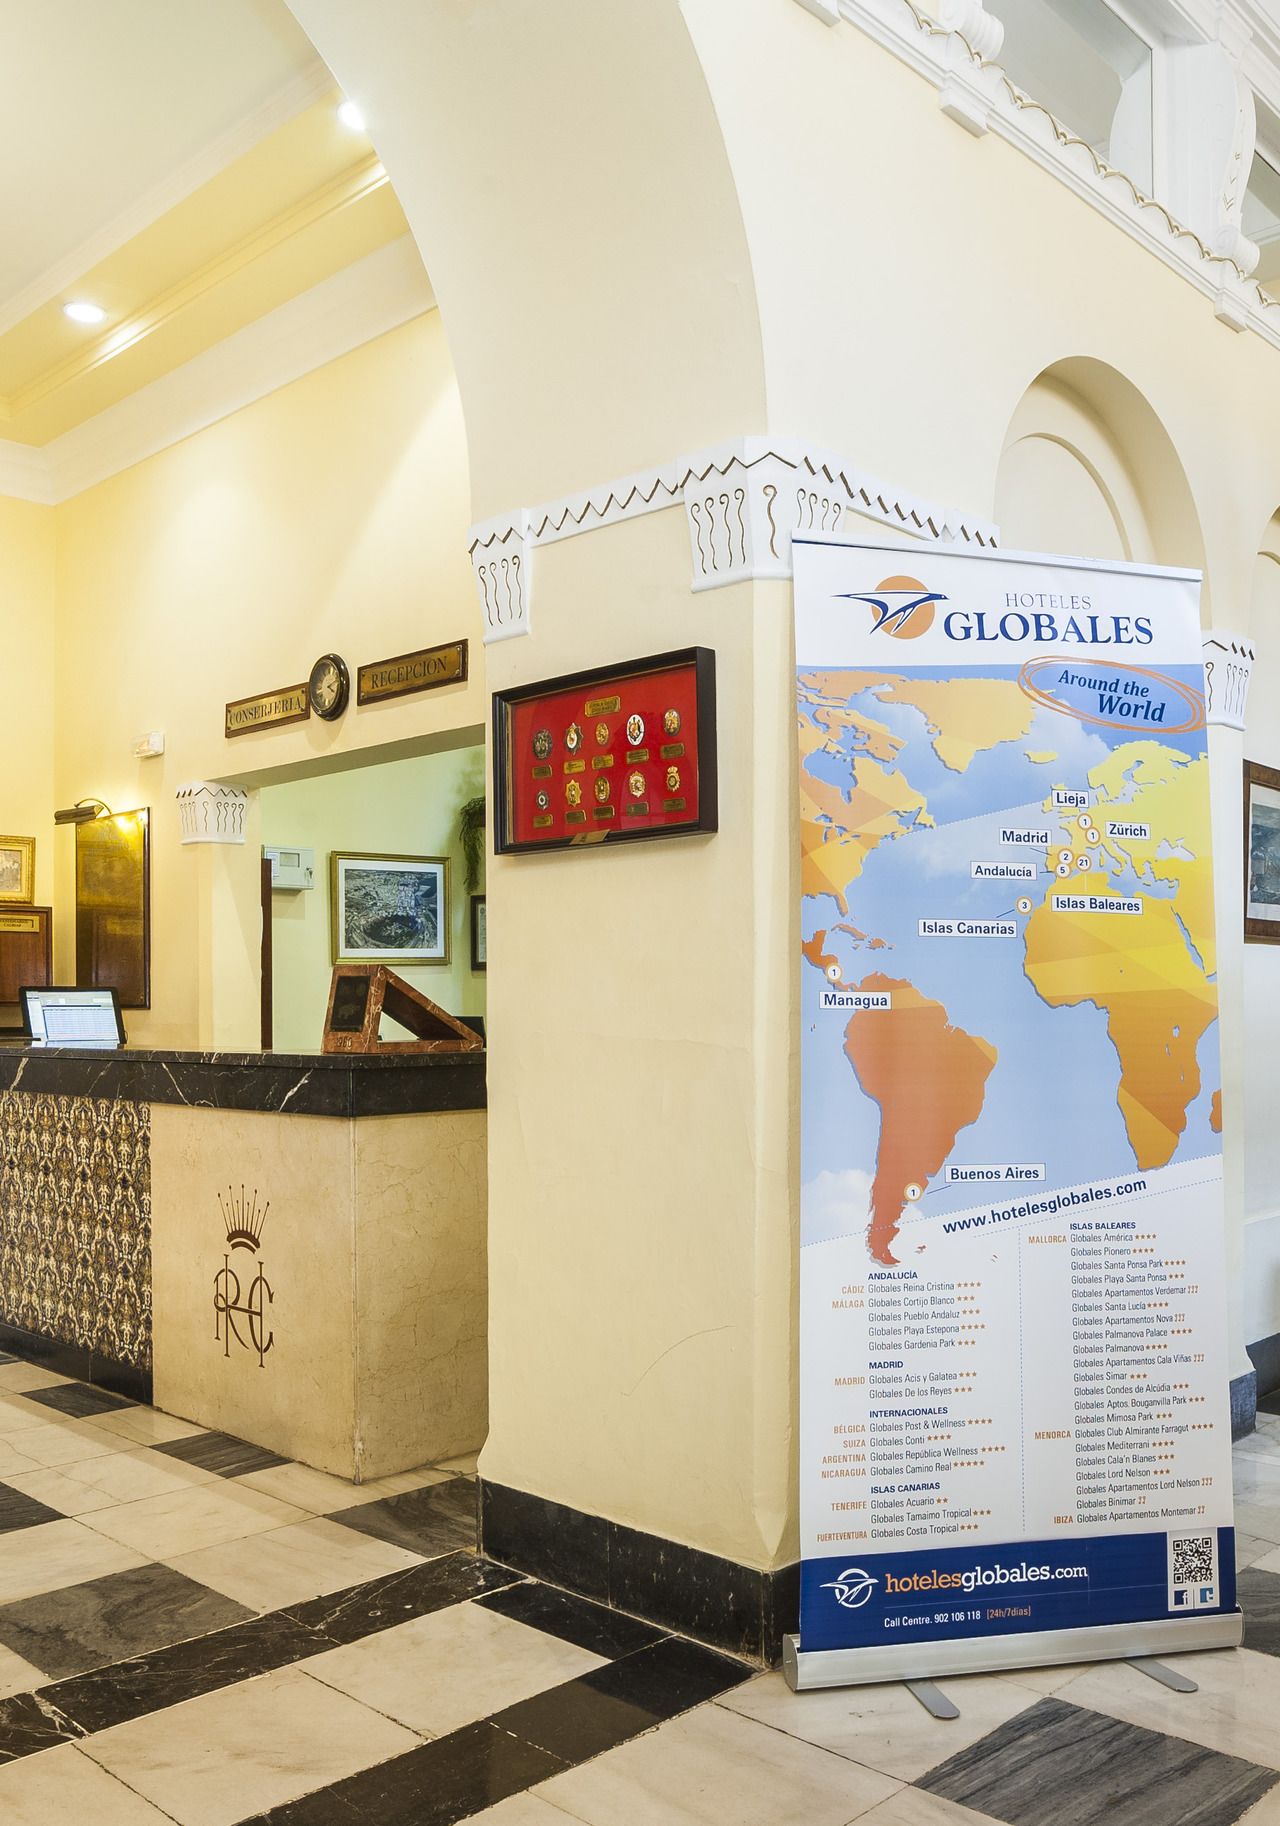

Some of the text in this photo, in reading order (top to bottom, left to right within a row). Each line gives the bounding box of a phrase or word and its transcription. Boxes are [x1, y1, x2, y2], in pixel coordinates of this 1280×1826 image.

[1005, 593, 1092, 610] HOTELES
[943, 611, 1154, 646] GLOBALES
[371, 656, 447, 690] RECEPCION
[1058, 670, 1149, 697] Around the
[229, 696, 301, 725] CONSERJERIA
[1099, 694, 1166, 722] World
[1056, 792, 1086, 807] Lieja
[1109, 823, 1147, 837] Zürich
[1002, 831, 1048, 844] Madrid
[975, 866, 1032, 877] Andalucía
[1056, 898, 1140, 912] Islas Baleares
[922, 922, 1014, 935] Islas Canarias
[824, 994, 887, 1009] Managua
[950, 1167, 1040, 1180] Buenos Aires
[942, 1179, 1147, 1234] www.hotelesglobales.com
[1029, 1235, 1067, 1244] MALLORCA
[1070, 1233, 1102, 1243] Globales
[1071, 1247, 1131, 1256] Globales Pionero
[1071, 1259, 1163, 1270] Globales Santa Ponsa Park
[868, 1271, 918, 1280] ANDALUCÍA
[1071, 1273, 1167, 1285] Globales Playa Santa Ponsa
[868, 1284, 901, 1293] Globales
[903, 1283, 924, 1291] Reina
[926, 1282, 955, 1290] Cristina
[868, 1298, 902, 1307] Globales
[904, 1297, 929, 1307] Cortijo
[930, 1296, 955, 1305] Blanco
[1072, 1303, 1103, 1312] Globales
[1105, 1302, 1126, 1311] Santa
[868, 1310, 960, 1322] Globales Pueblo Andaluz
[869, 1324, 960, 1336] Globales Playa Estepona
[1073, 1328, 1168, 1340] Globales Palmanova Palace
[869, 1339, 955, 1351] Globales Gardenia Park
[1073, 1344, 1144, 1354] Globales Palmanova
[869, 1361, 904, 1369] MADRID
[1073, 1358, 1104, 1368] Globales
[1106, 1357, 1155, 1368] Apartamentos
[1157, 1356, 1171, 1364] Cala
[834, 1372, 957, 1386] MADRID Globales Acis y Galatea
[869, 1386, 952, 1399] Globales De los Reyes
[1074, 1387, 1104, 1396] Globales
[1106, 1385, 1133, 1394] Condes
[1135, 1385, 1144, 1393] de
[870, 1407, 948, 1418] INTERNACIONALES
[1075, 1412, 1153, 1424] Globales Mimosa Park
[870, 1422, 903, 1432] Globales
[905, 1421, 921, 1430] Post
[923, 1420, 929, 1429] &
[932, 1419, 966, 1428] Wellness
[1035, 1431, 1071, 1440] MENORCA
[1075, 1429, 1105, 1438] Globales
[1107, 1427, 1123, 1436] Club
[1125, 1425, 1160, 1435] Almirante
[843, 1436, 925, 1448] SUIZA Globales Conti
[1076, 1440, 1149, 1452] Globales Mediterrani
[822, 1454, 866, 1464] ARGENTINA
[870, 1451, 904, 1461] Globales
[943, 1446, 978, 1456] Wellness
[1076, 1457, 1105, 1466] Globales
[822, 1461, 951, 1479] NICARAGUA Globales Camino Real
[1076, 1468, 1151, 1481] Globales Lord Nelson
[871, 1482, 940, 1494] ISLAS CANARIAS
[1076, 1478, 1200, 1495] Globales Apartamentos Lord Nelson
[832, 1497, 934, 1511] TENERIFE Globales Acuario
[1077, 1499, 1106, 1509] Globales
[871, 1514, 905, 1524] Globales
[942, 1508, 971, 1519] Tropical
[1054, 1507, 1196, 1524] IBIZA Globales Apartamentos Montemar
[871, 1528, 905, 1539] Globales
[907, 1526, 928, 1536] Costa
[930, 1524, 959, 1534] Tropical
[885, 1563, 1089, 1593] hotelesglobales.com
[884, 1618, 900, 1627] Call
[902, 1616, 932, 1626] Centre.
[935, 1613, 948, 1623] 902
[952, 1612, 964, 1621] 106
[968, 1611, 980, 1620] 118
